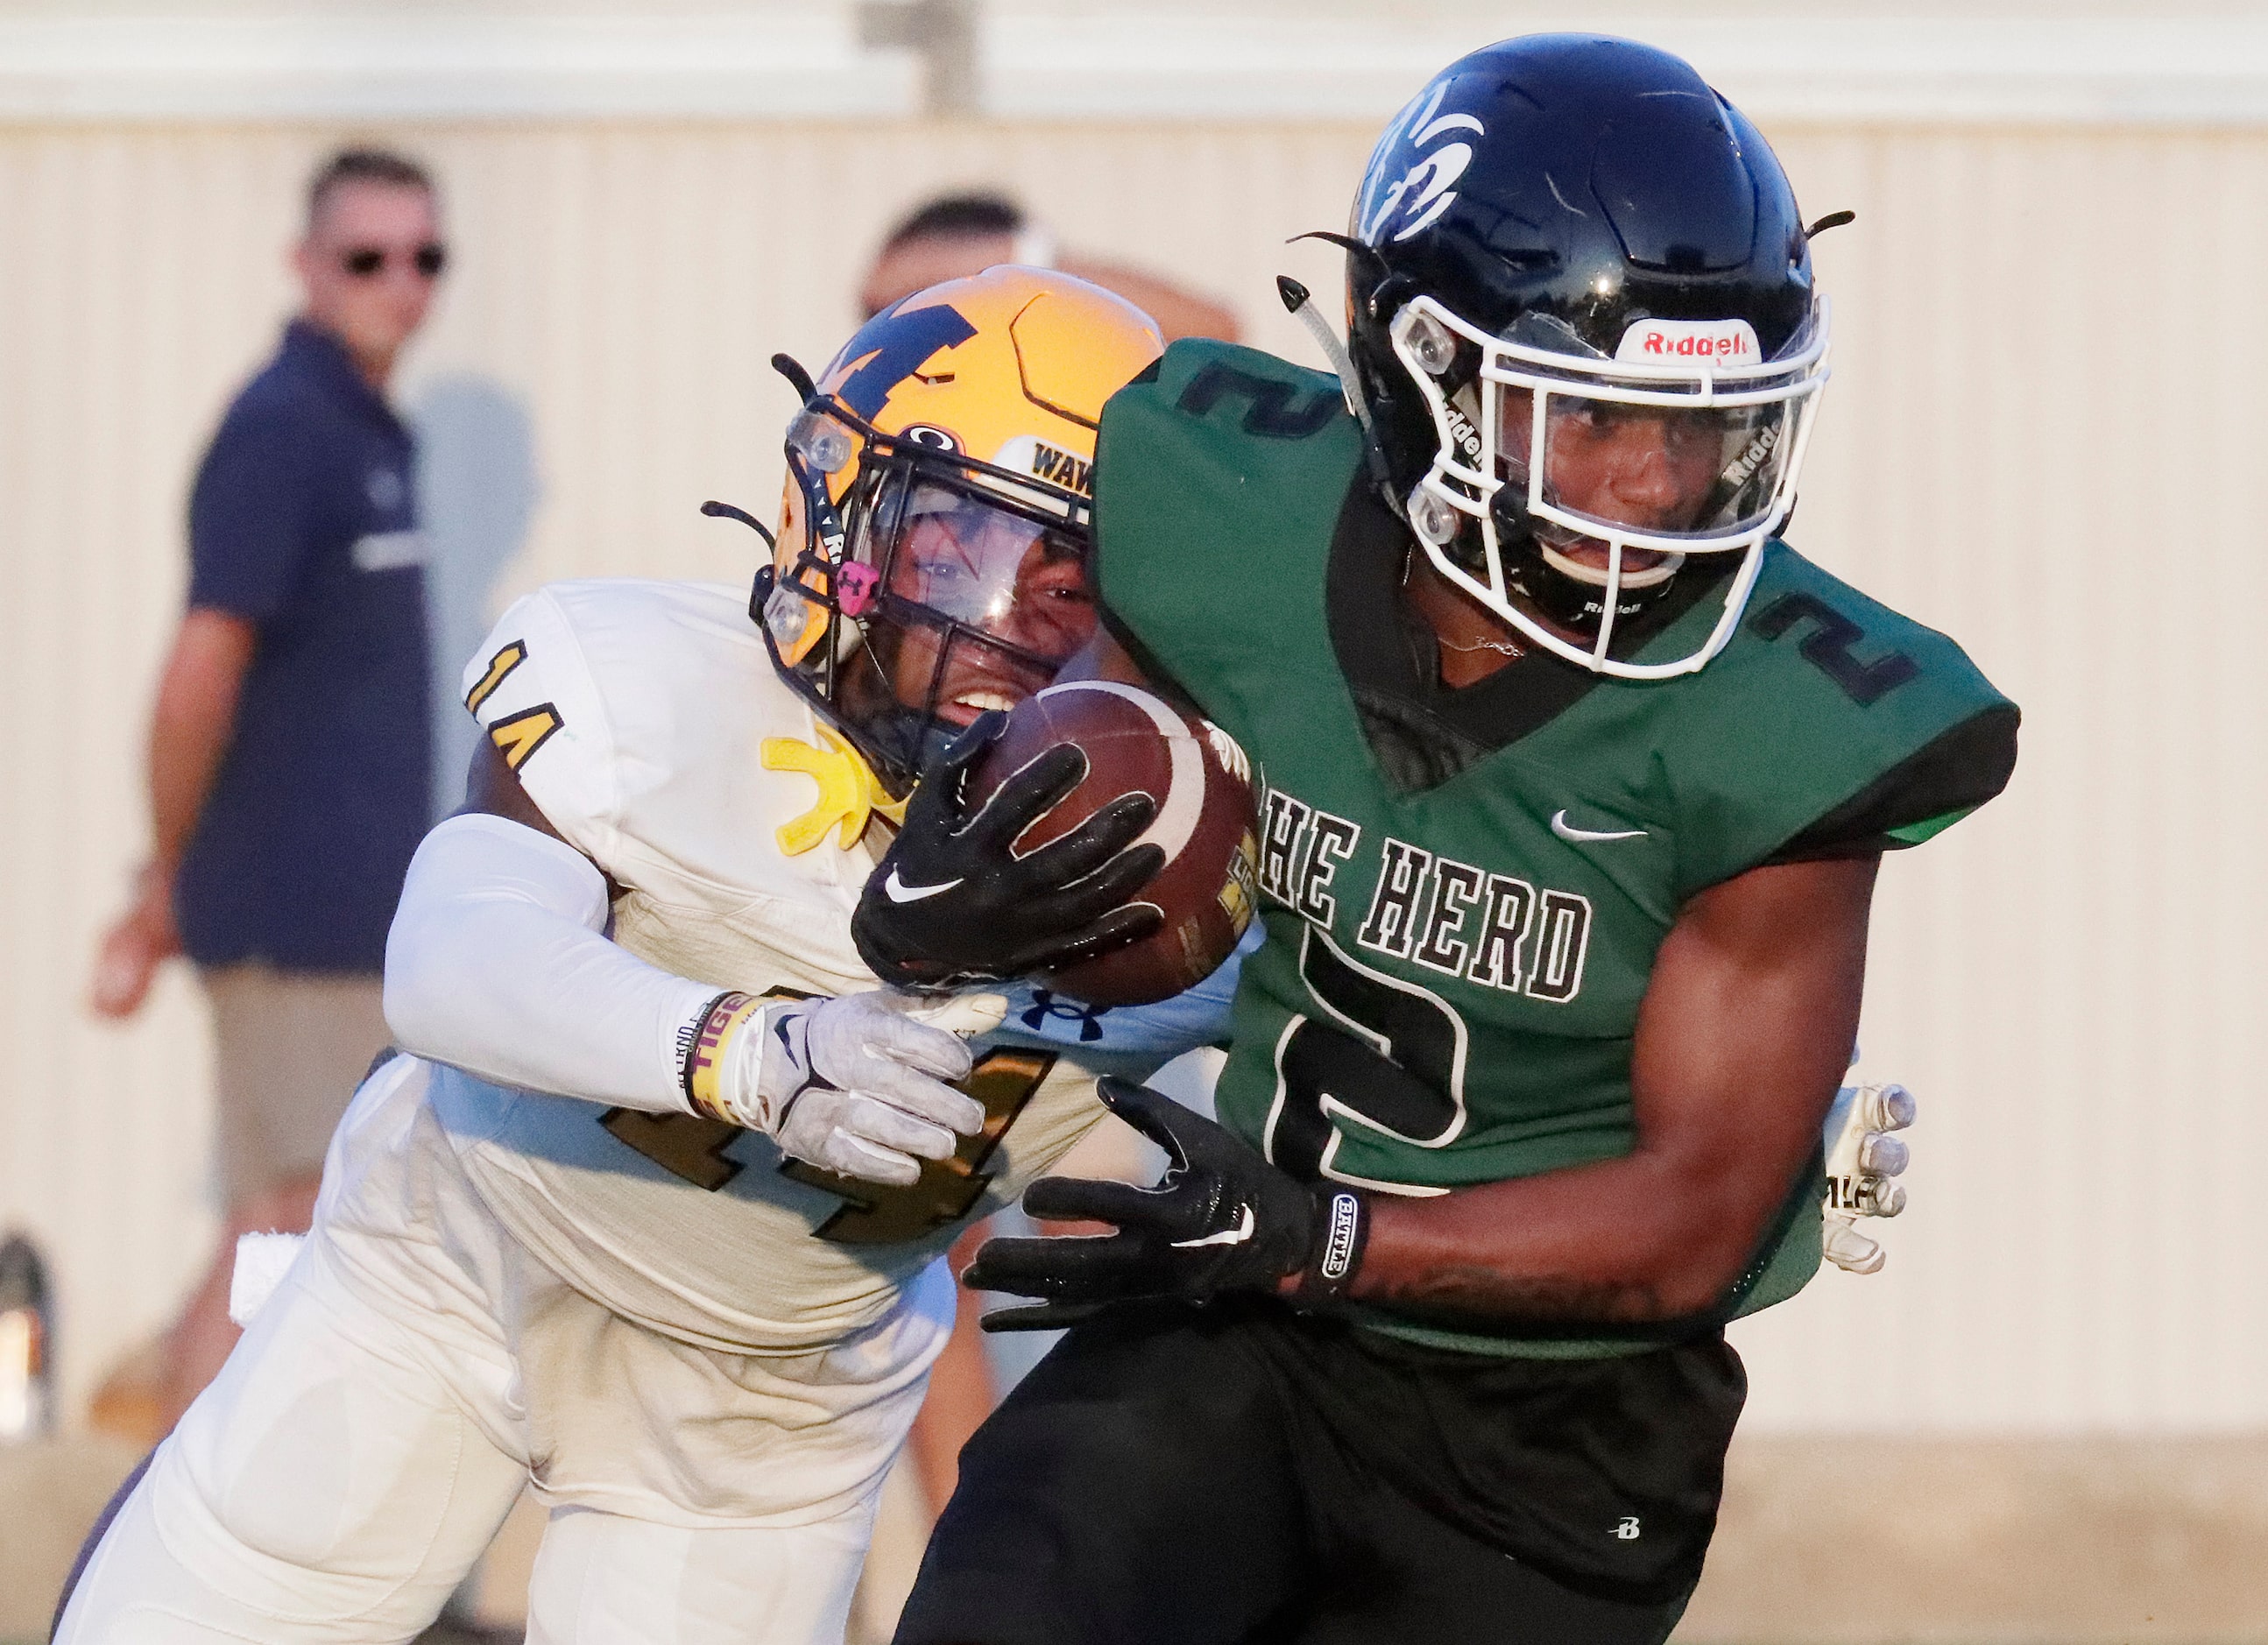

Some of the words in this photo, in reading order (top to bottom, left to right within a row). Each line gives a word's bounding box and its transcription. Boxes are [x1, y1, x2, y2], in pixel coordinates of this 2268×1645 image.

[1643, 332, 1748, 356] Riddell
[1175, 360, 1346, 437] 2
[1748, 592, 1921, 709] 2
[1257, 760, 1361, 930] HE
[1357, 837, 1593, 1004] HERD
[1263, 920, 1469, 1197] 2
[1327, 1198, 1353, 1272] BATTLE
